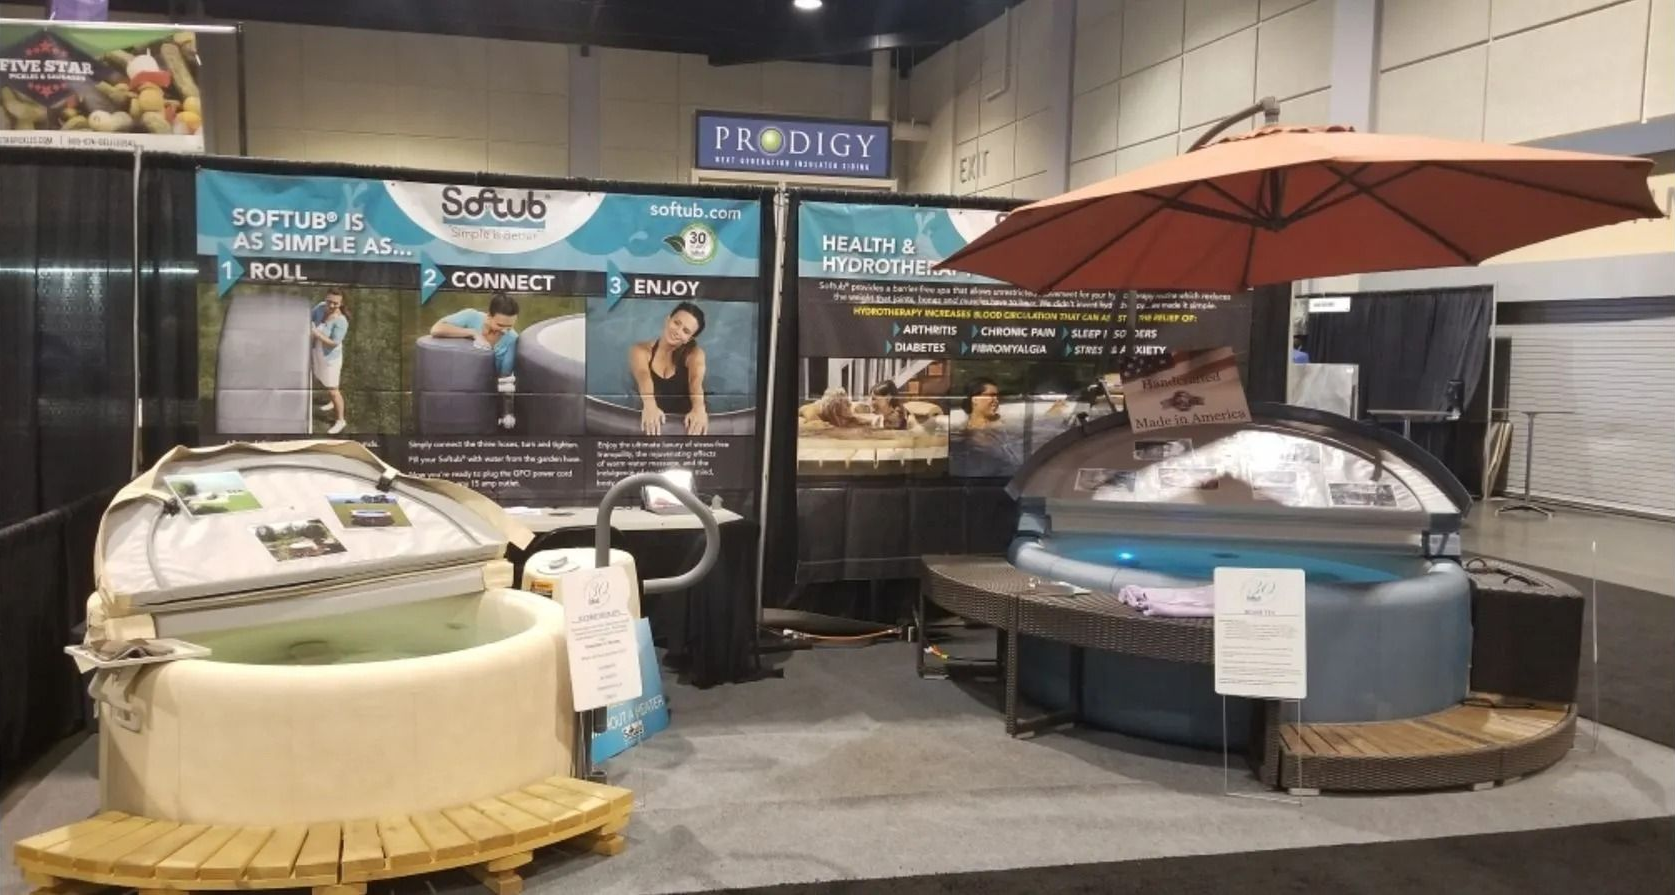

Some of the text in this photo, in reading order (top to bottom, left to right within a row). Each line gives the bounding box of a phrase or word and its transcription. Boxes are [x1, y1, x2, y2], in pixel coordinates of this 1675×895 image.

[0, 58, 94, 75] FIVE STAR
[715, 126, 875, 157] PRODIGY
[740, 157, 789, 167] GENERATION
[842, 162, 869, 171] SIDING
[442, 185, 546, 219] Softub
[650, 201, 742, 220] softub.com
[344, 212, 364, 231] IS
[233, 231, 412, 256] AS SIMPLE AS...
[689, 231, 706, 244] 30
[823, 235, 915, 255] HEALTH &
[221, 261, 231, 280] 1
[249, 262, 308, 281] ROLL
[423, 268, 437, 286] 2
[451, 271, 556, 291] CONNECT
[609, 276, 621, 294] 3
[634, 278, 700, 296] ENJOY
[833, 291, 847, 300] the
[849, 292, 874, 302] weight
[876, 294, 891, 302] that
[918, 295, 940, 304] bones
[1053, 299, 1075, 307] didn't
[1183, 301, 1188, 309] it
[851, 283, 884, 292] provides
[937, 287, 950, 295] spa
[952, 286, 967, 294] that
[970, 286, 991, 296] allows
[1091, 291, 1106, 300] your
[1179, 291, 1199, 299] which
[1201, 292, 1231, 300] reduces
[853, 306, 922, 316] HYDROTHERAPY
[925, 308, 970, 318] INCREASES
[973, 310, 1002, 319] BLOOD
[1004, 311, 1057, 320] CIRCULATION
[1059, 312, 1080, 321] THAT
[1082, 313, 1099, 321] CAN
[1153, 314, 1179, 322] RELIEF
[902, 324, 957, 335] ARTHRITIS
[981, 326, 1056, 337] CHRONIC PAIN
[1071, 329, 1101, 339] SLEEP
[894, 342, 945, 353] DIABETES
[971, 343, 1047, 354] FIBROMYALGIA
[1142, 371, 1222, 391] Handcrafted
[1135, 408, 1247, 429] Made in America
[408, 440, 432, 450] Simply
[477, 440, 496, 448] three
[597, 441, 617, 450] Enjoy
[662, 441, 683, 449] luxury
[408, 455, 419, 463] Fill
[420, 457, 436, 465] your
[537, 455, 562, 464] garden
[649, 451, 692, 459] rejuvenating
[452, 470, 472, 478] ready
[483, 470, 499, 479] plug
[533, 471, 555, 479] power
[556, 469, 572, 478] cord
[471, 480, 480, 488] 15
[481, 481, 497, 489] amp
